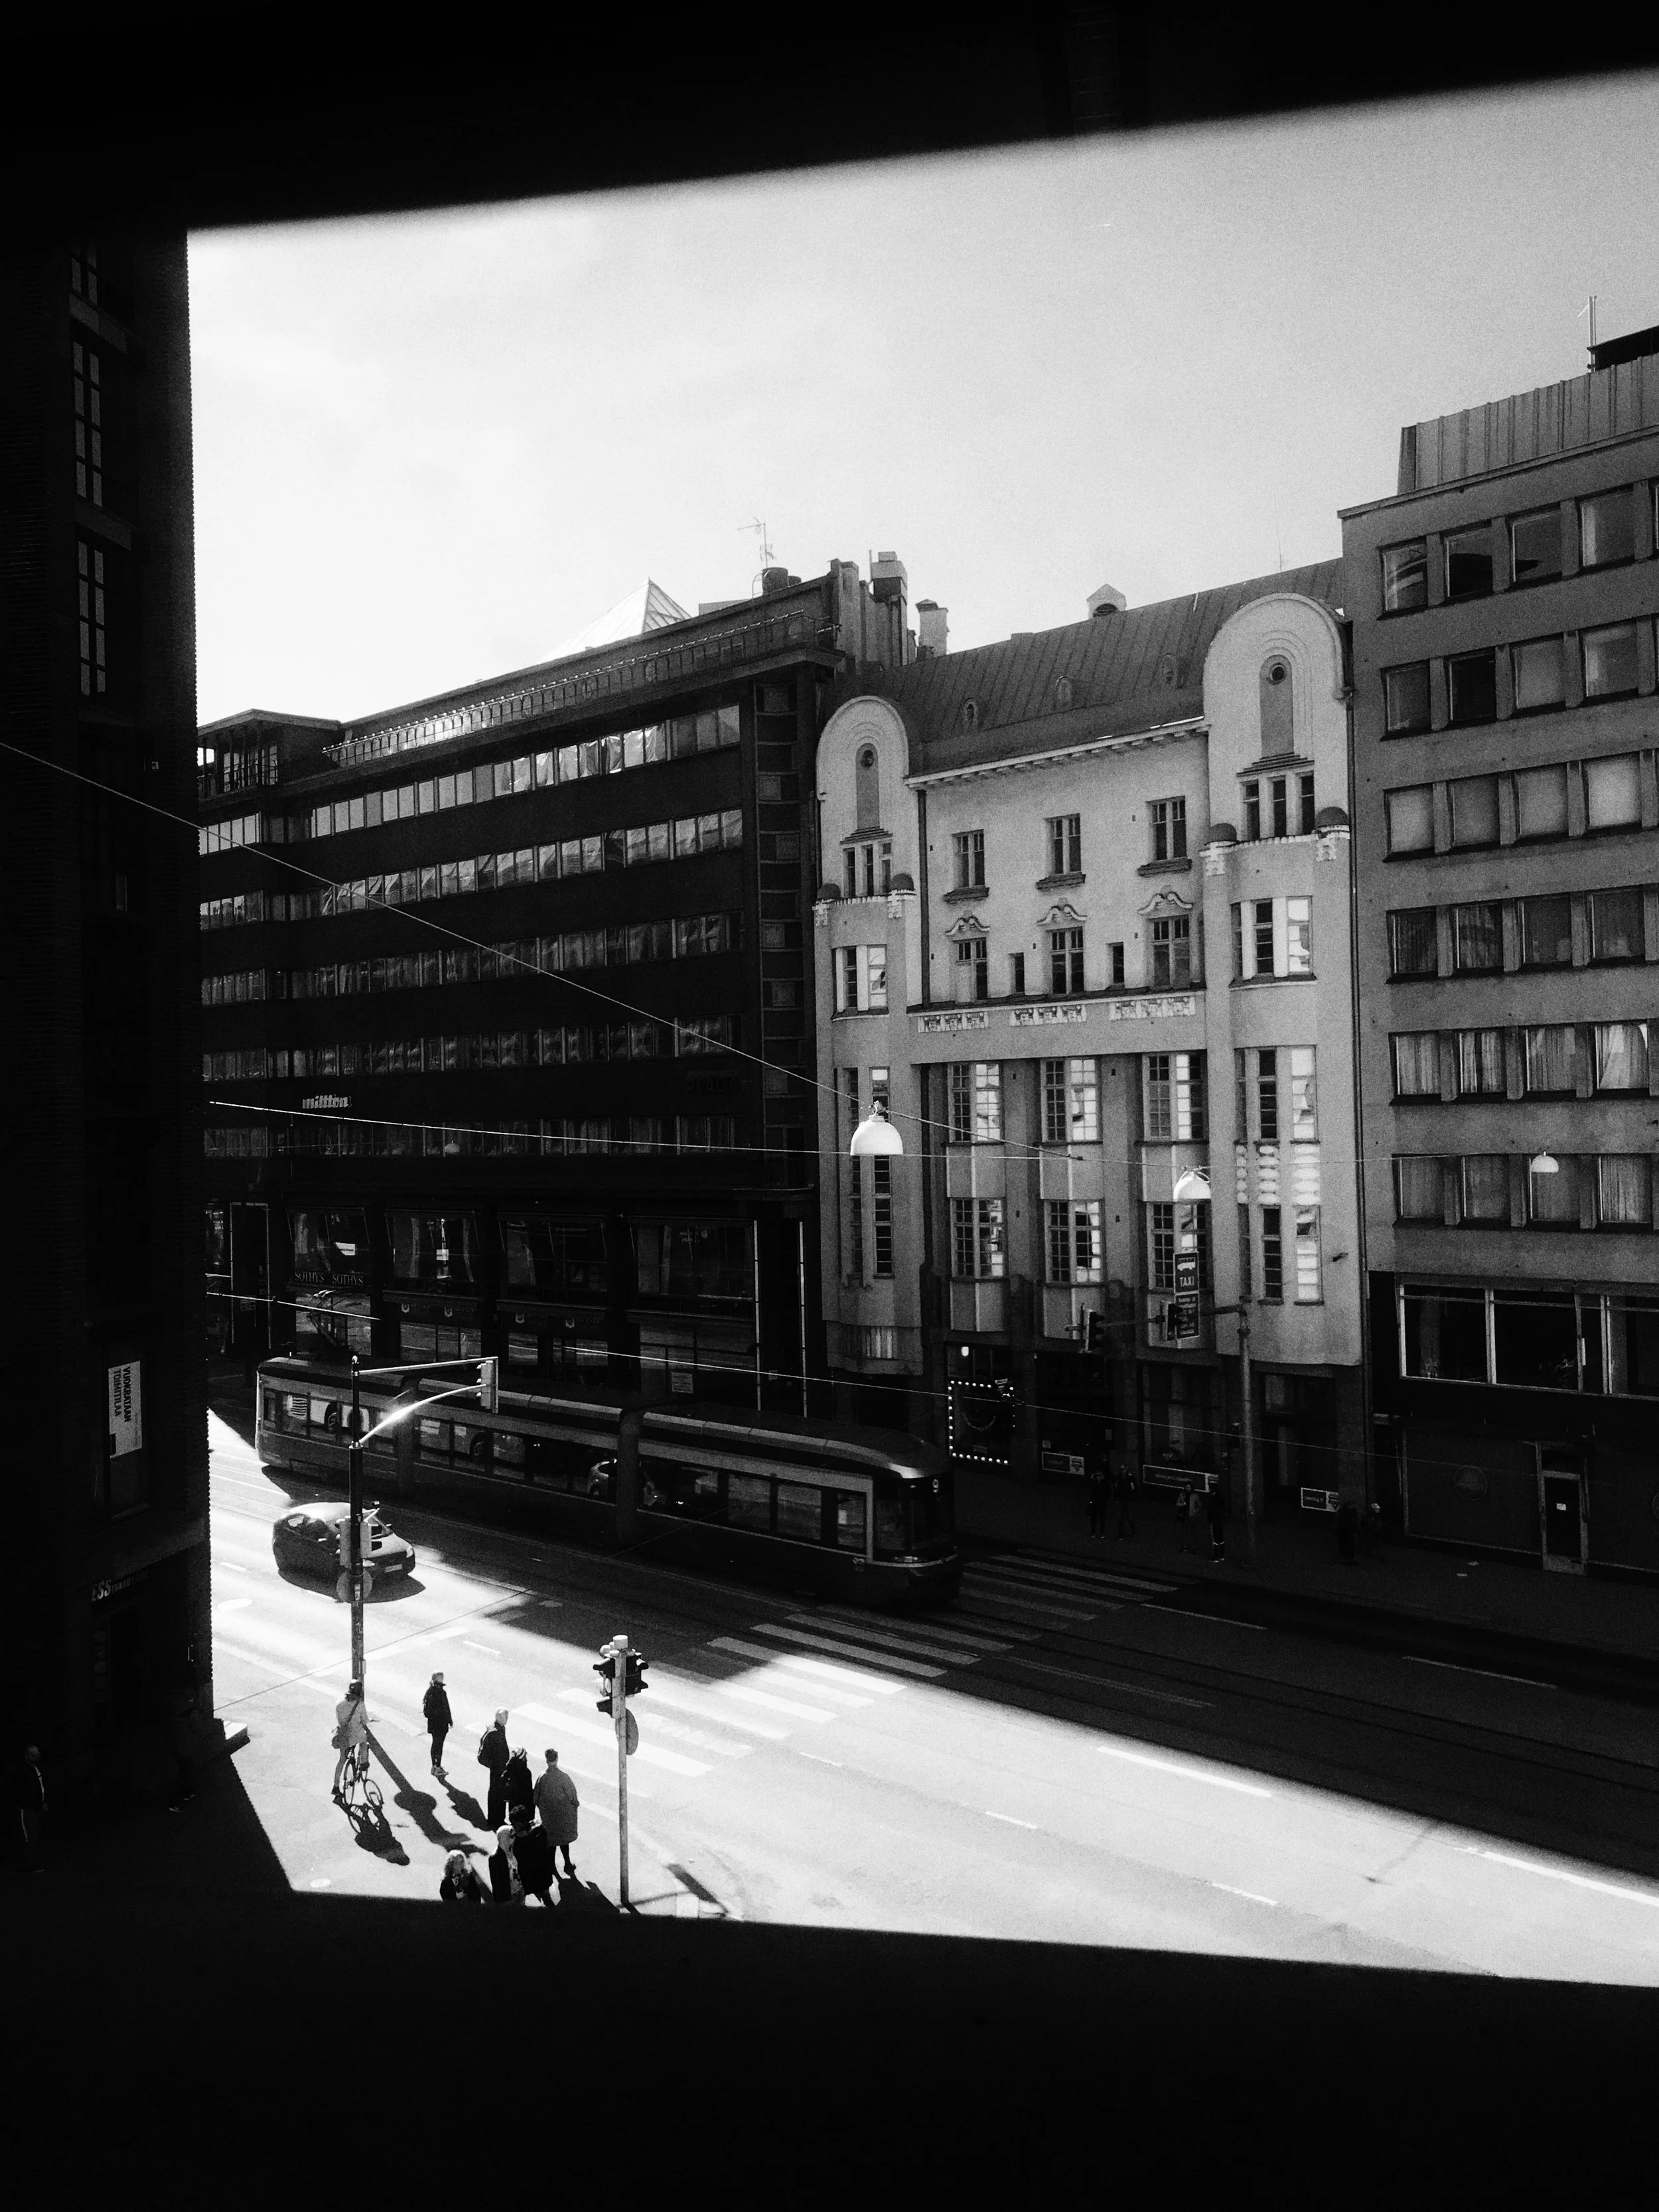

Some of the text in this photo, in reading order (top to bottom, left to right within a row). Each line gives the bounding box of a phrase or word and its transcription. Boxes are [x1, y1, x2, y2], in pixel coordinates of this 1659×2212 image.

[295, 1270, 363, 1286] SOTHYS SOTHYS
[1179, 1276, 1194, 1287] TAXI
